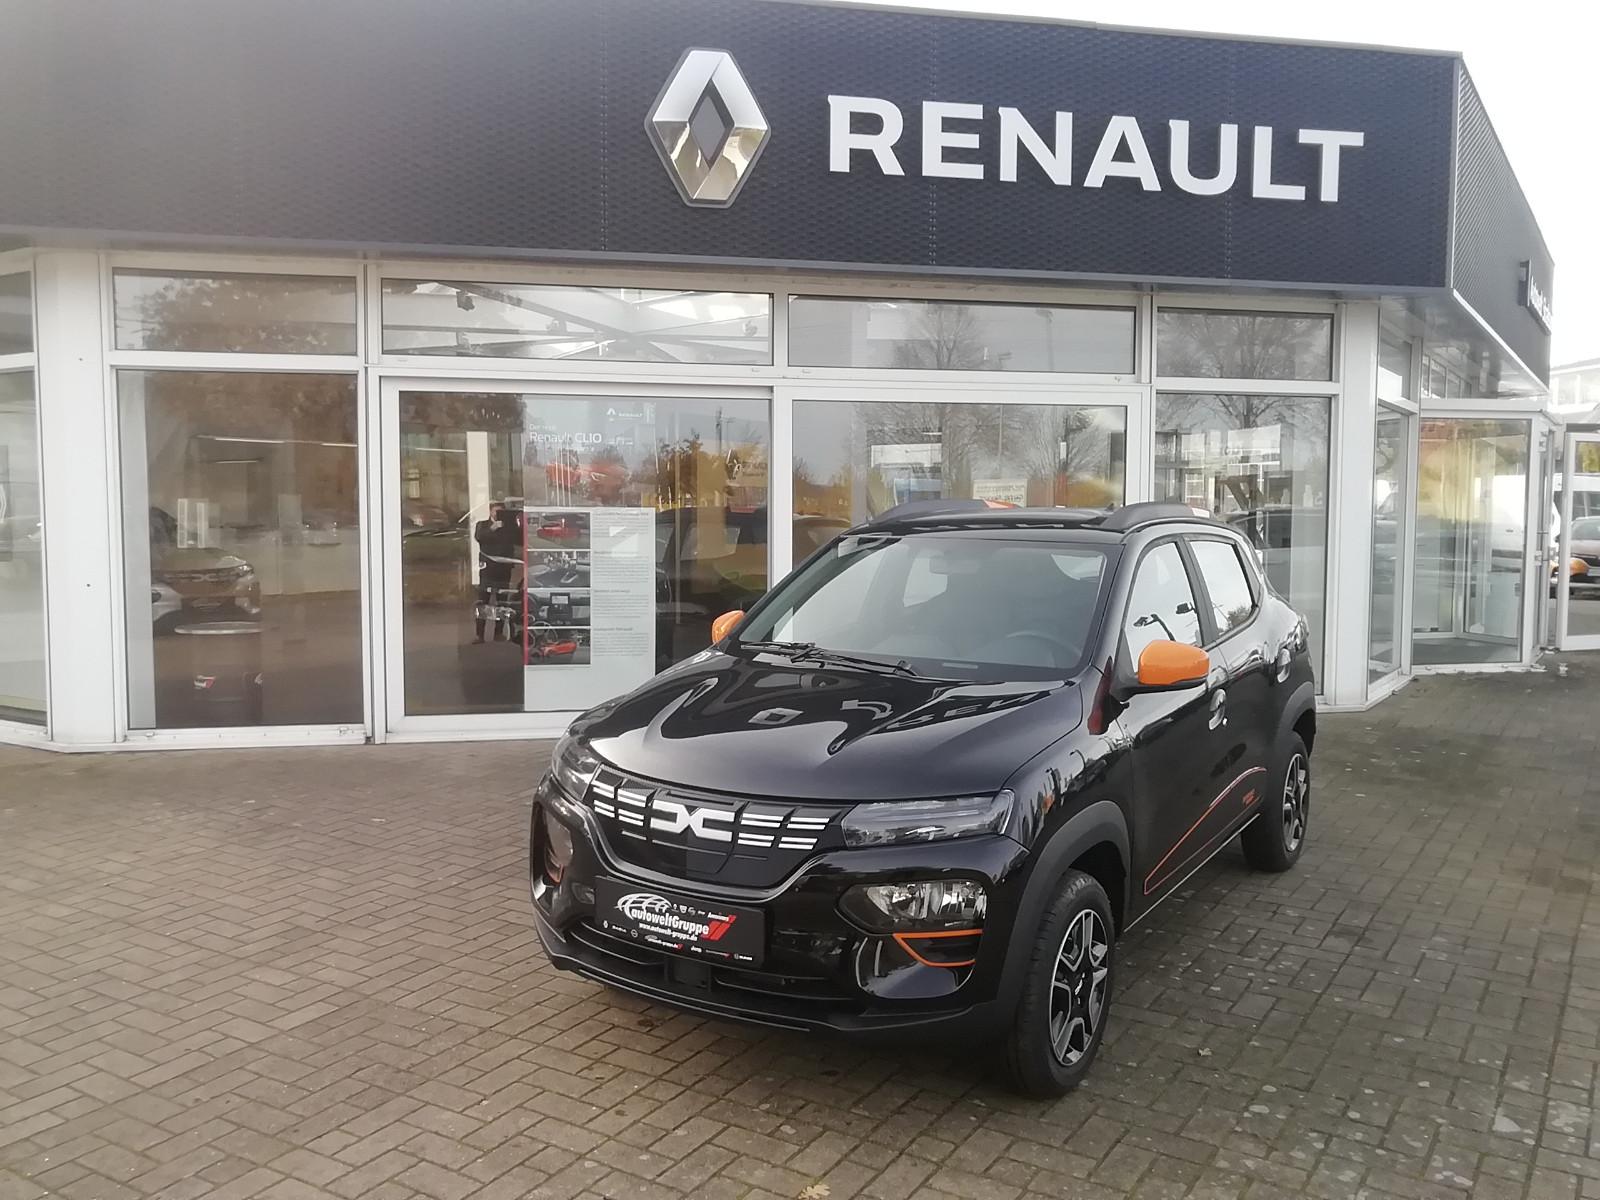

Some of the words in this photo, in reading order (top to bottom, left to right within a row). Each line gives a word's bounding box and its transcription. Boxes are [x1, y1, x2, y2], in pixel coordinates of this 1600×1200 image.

[827, 94, 1365, 202] RENAULT
[529, 431, 571, 442] Renault
[574, 432, 602, 443] CLIO
